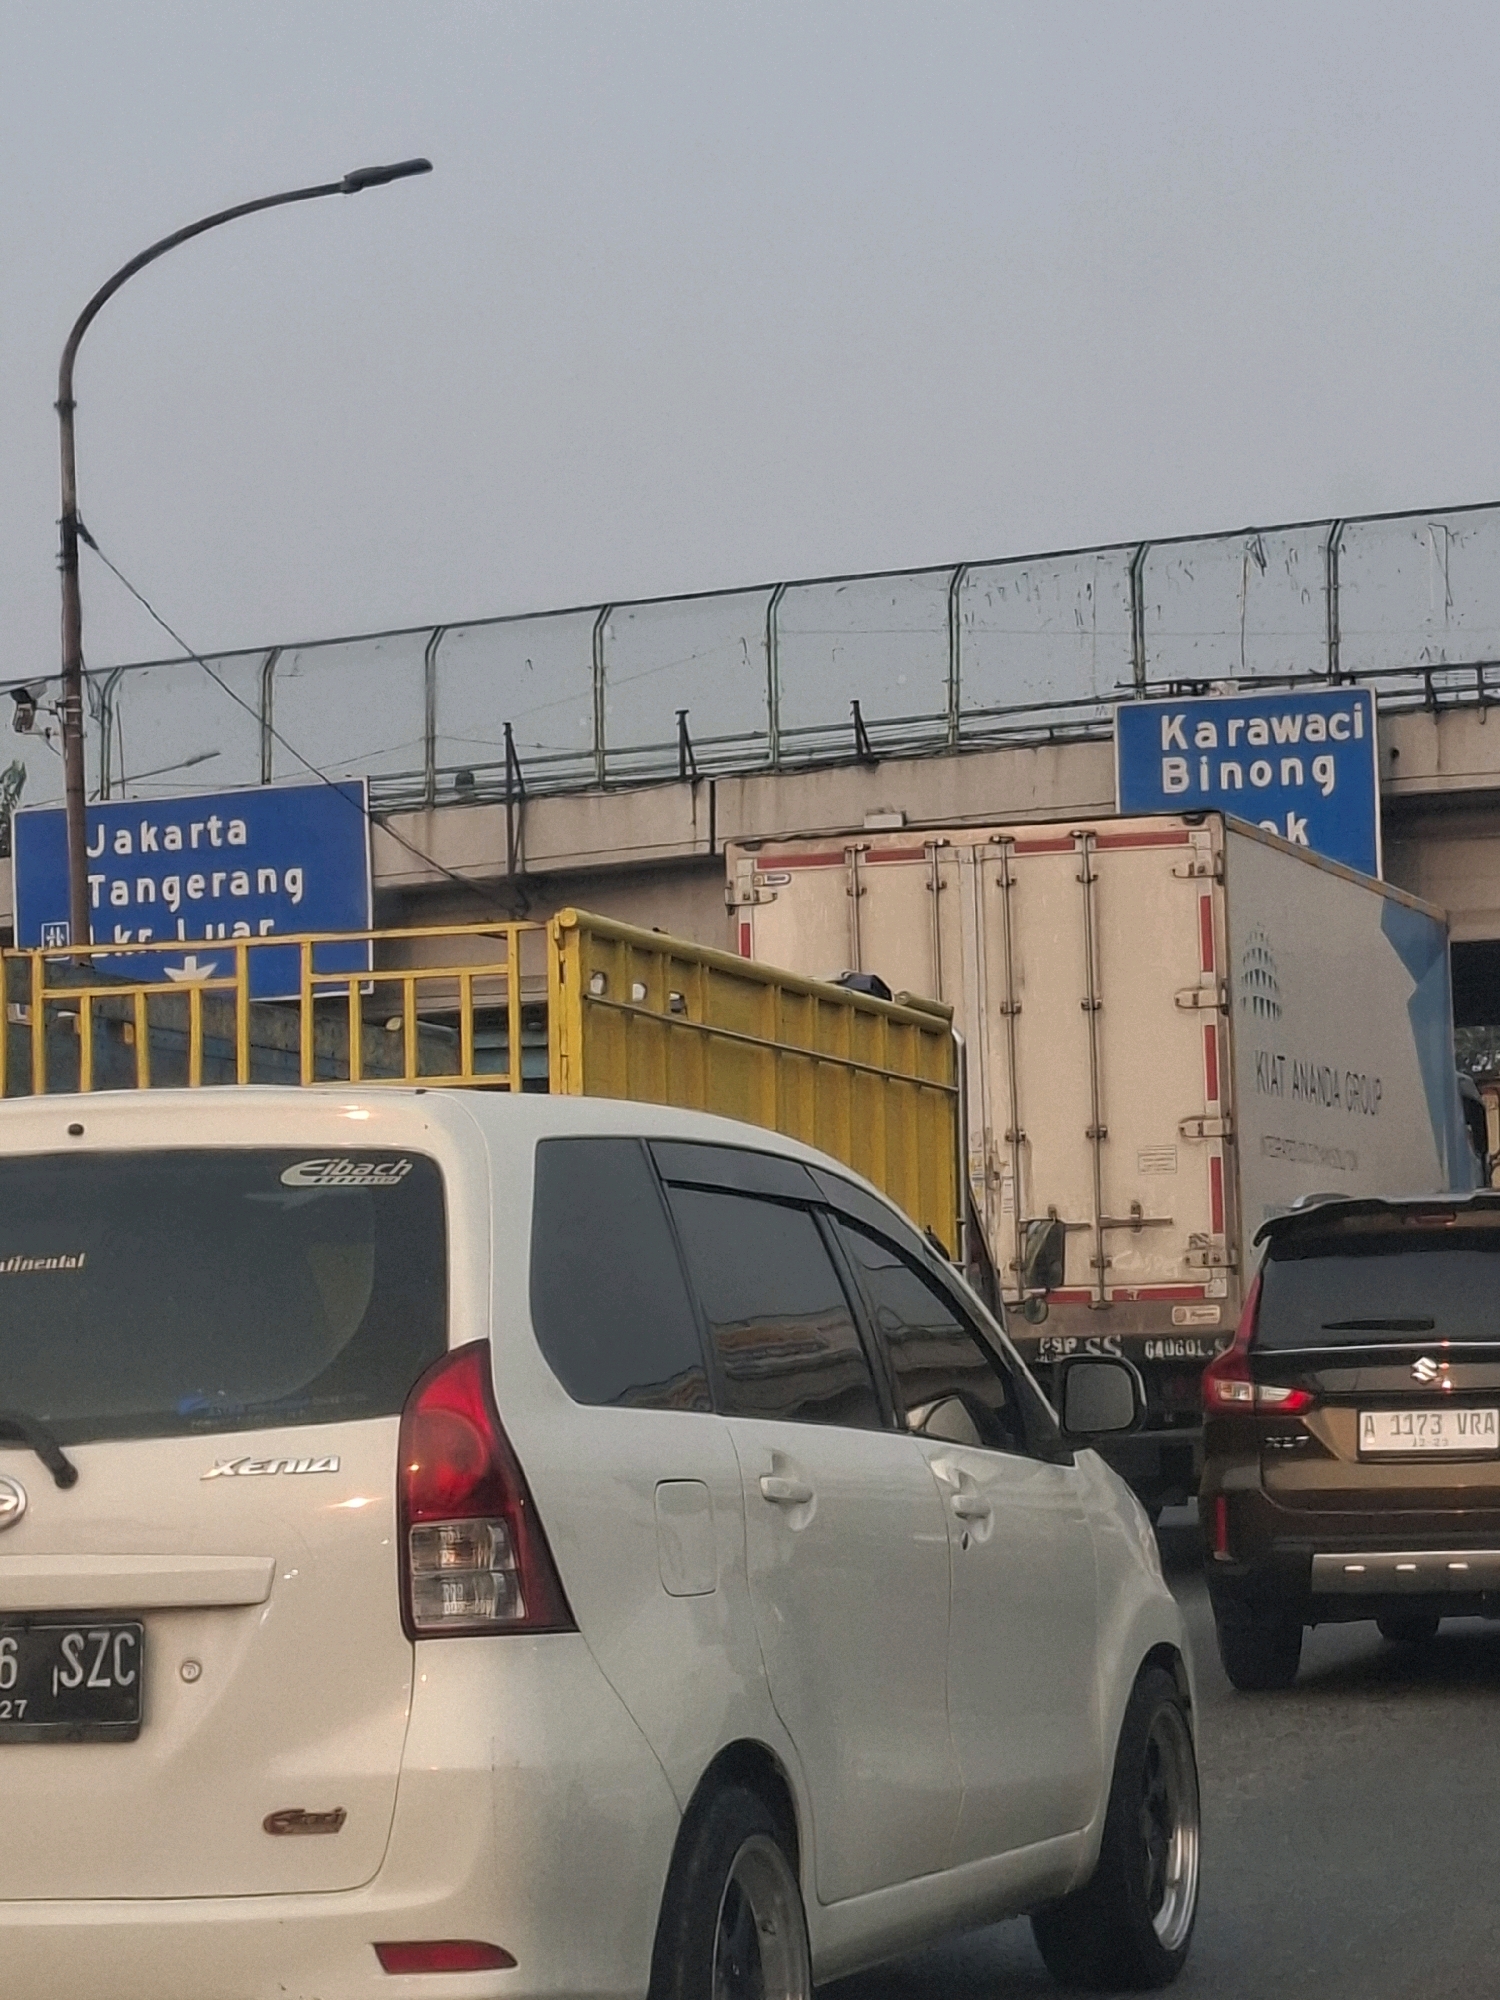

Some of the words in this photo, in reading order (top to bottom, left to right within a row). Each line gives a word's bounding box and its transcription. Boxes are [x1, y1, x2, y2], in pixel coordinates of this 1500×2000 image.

[1161, 702, 1364, 751] Karawaci
[1161, 755, 1335, 797] Binong
[86, 815, 247, 858] Jakarta
[87, 867, 303, 913] Tangerang
[1254, 1050, 1286, 1098] KIAT
[1291, 1058, 1341, 1107] ANANDA
[1344, 1070, 1382, 1116] GROUP
[281, 1158, 413, 1186] Eibach
[1364, 1415, 1375, 1438] A
[1390, 1413, 1442, 1436] 1173
[1457, 1411, 1495, 1435] VRA
[60, 1631, 136, 1688] SZC
